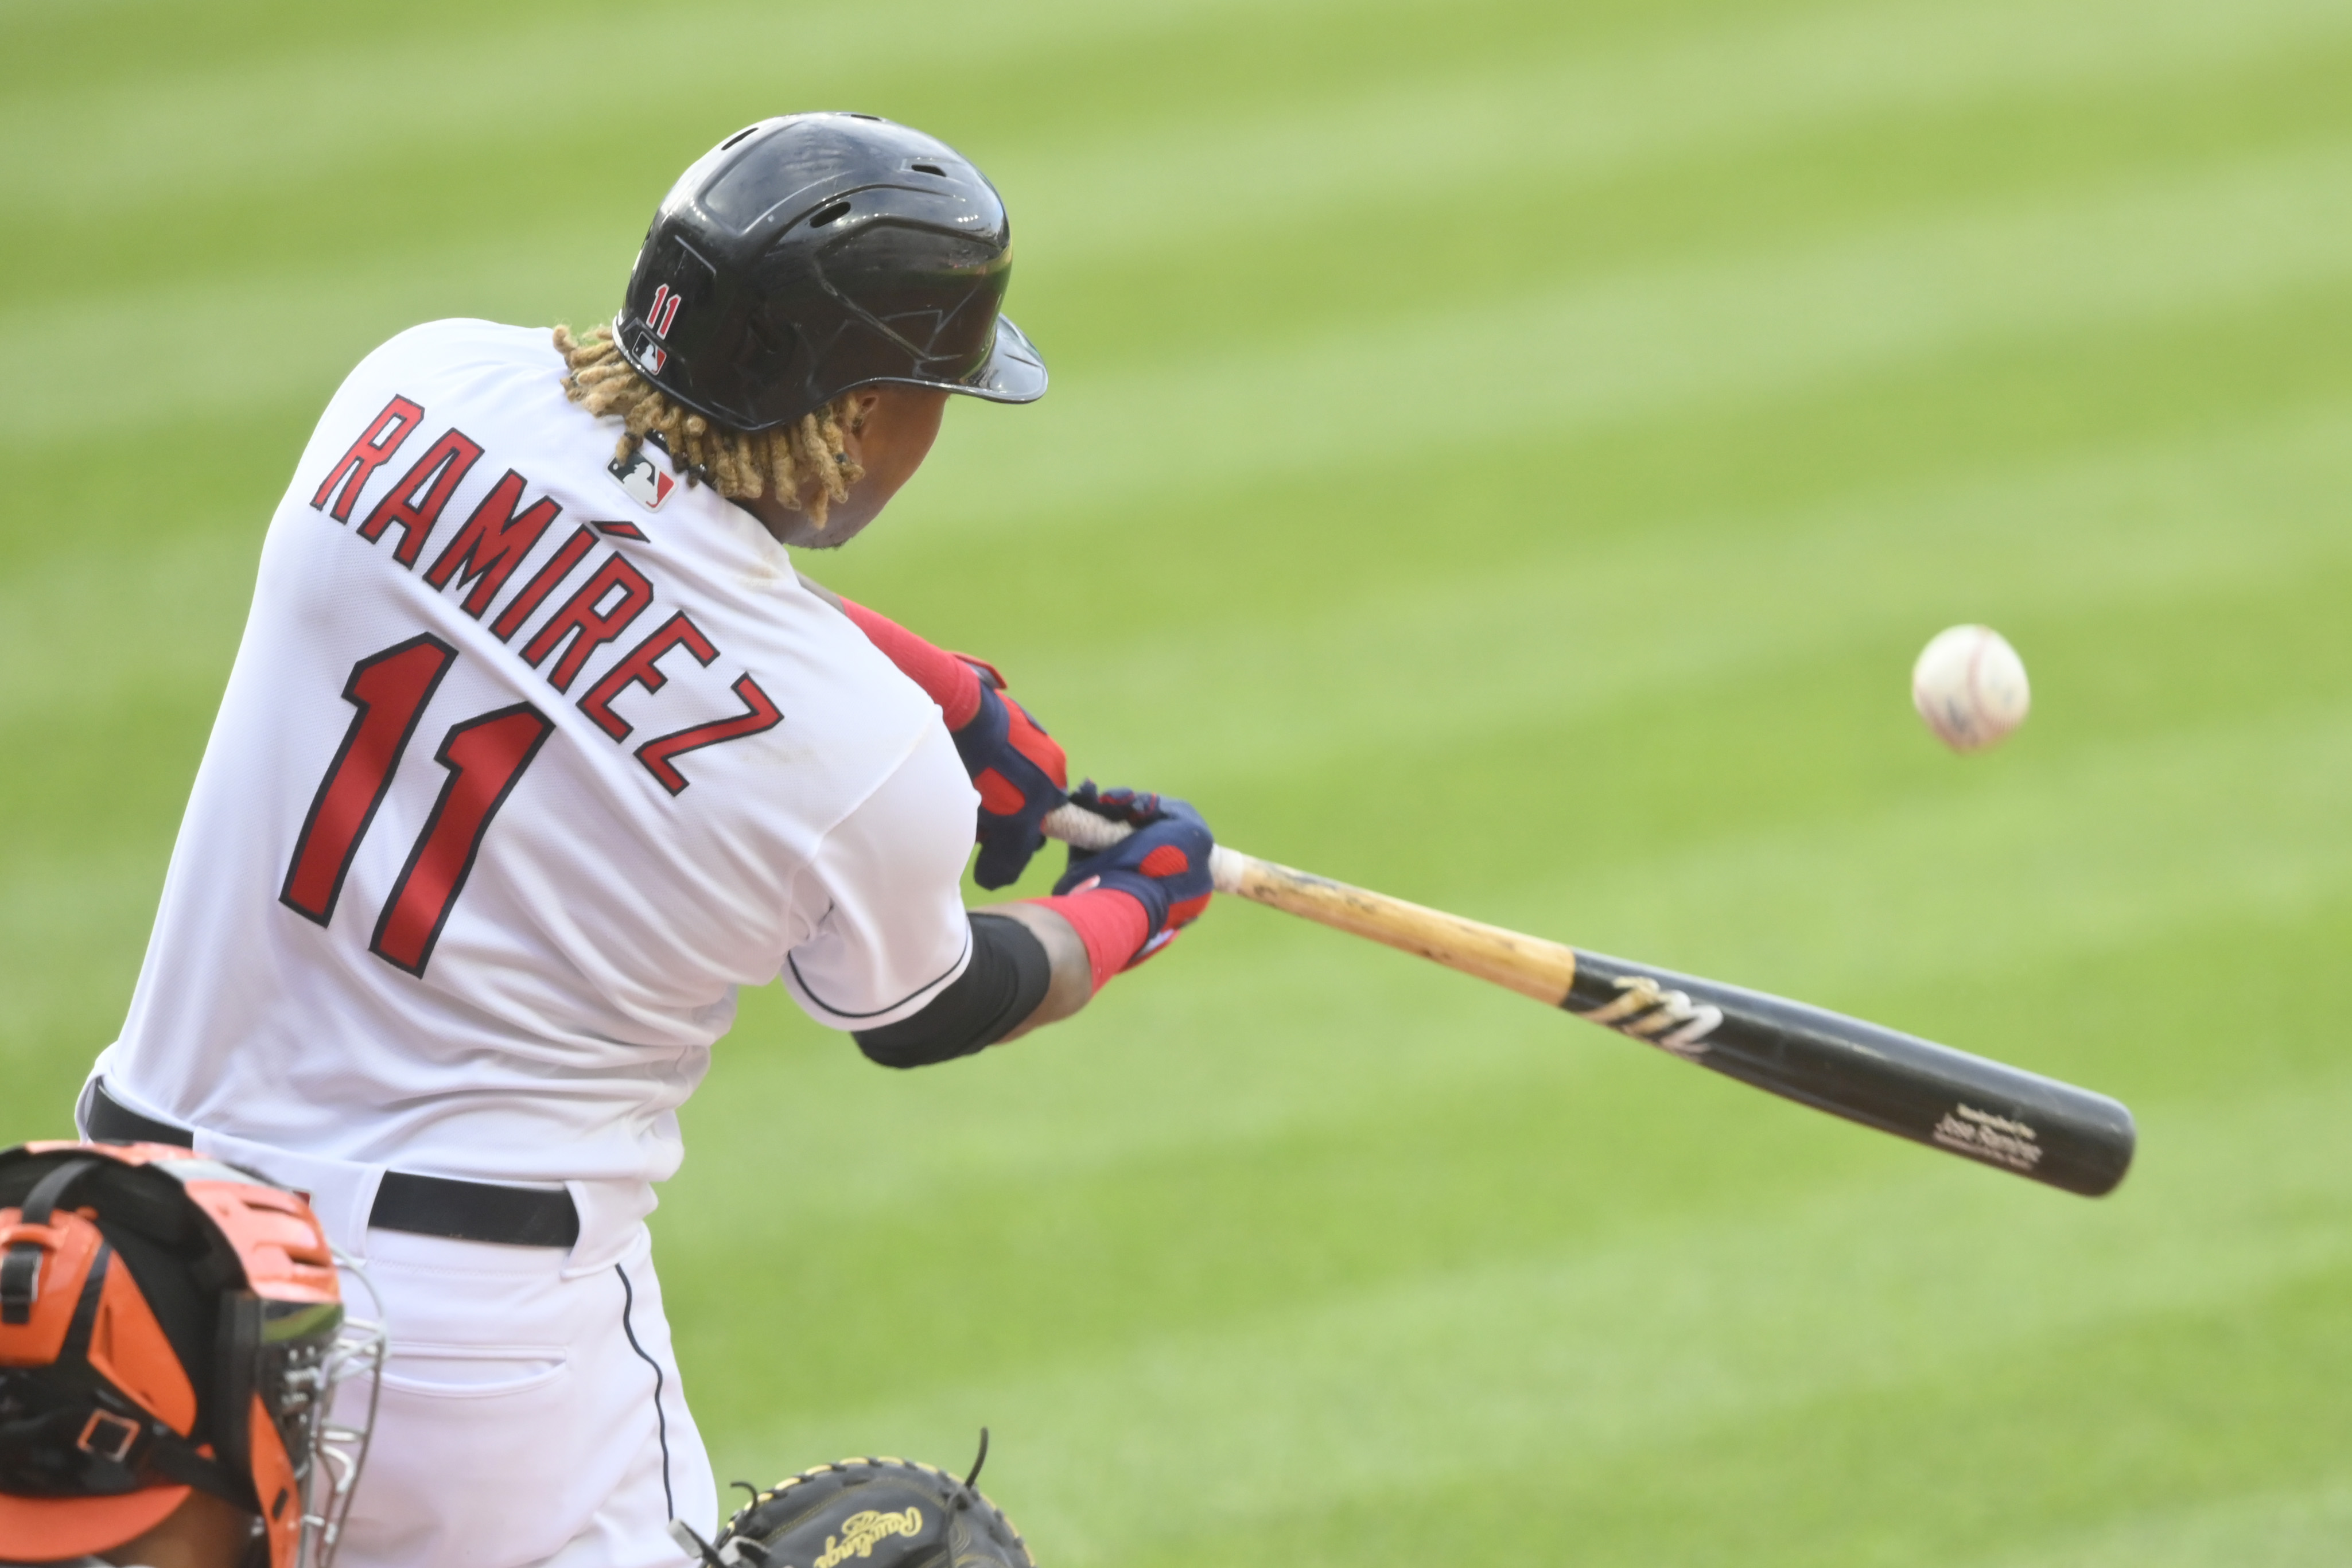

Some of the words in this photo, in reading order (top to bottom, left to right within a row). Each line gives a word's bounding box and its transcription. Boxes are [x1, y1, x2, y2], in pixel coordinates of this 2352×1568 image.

[646, 283, 681, 340] 11
[309, 394, 784, 797] RAMÍREZ
[278, 631, 556, 979] 11
